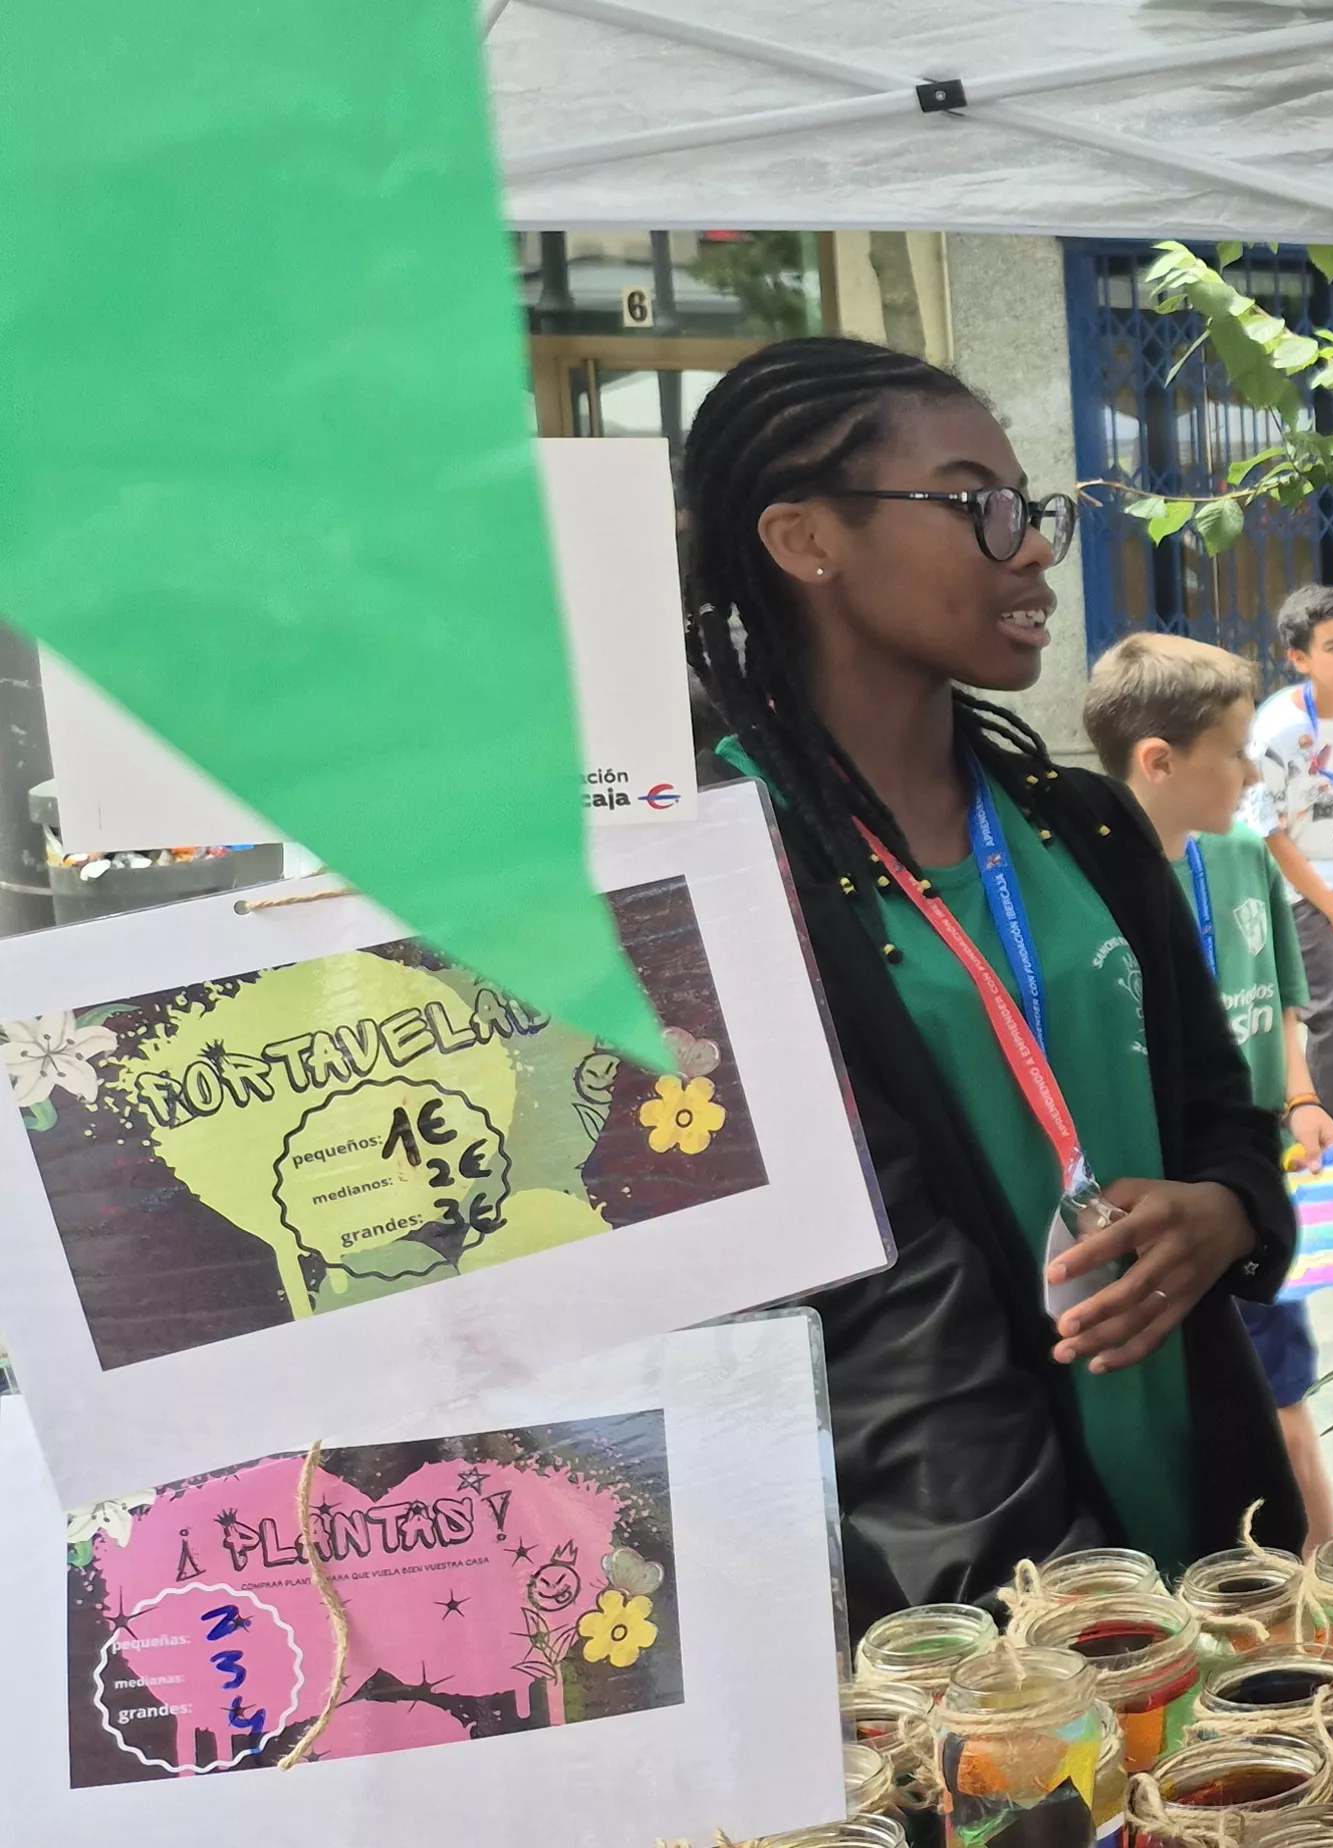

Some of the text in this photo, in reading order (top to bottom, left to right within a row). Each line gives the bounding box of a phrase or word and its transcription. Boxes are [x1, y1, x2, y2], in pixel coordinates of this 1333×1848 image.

[627, 290, 648, 322] 6
[381, 1097, 458, 1167] 1€
[291, 1134, 383, 1170] pequeños:
[426, 1138, 493, 1188] 2€
[311, 1176, 394, 1206] medianos:
[340, 1213, 424, 1249] grandes:
[433, 1192, 508, 1234] 3€
[214, 1495, 475, 1572] PLANTAS
[465, 1556, 490, 1567] CASA
[112, 1634, 191, 1655] pequeñas:
[114, 1674, 185, 1690] medianas:
[210, 1650, 247, 1689] 3
[118, 1703, 193, 1725] grandes:
